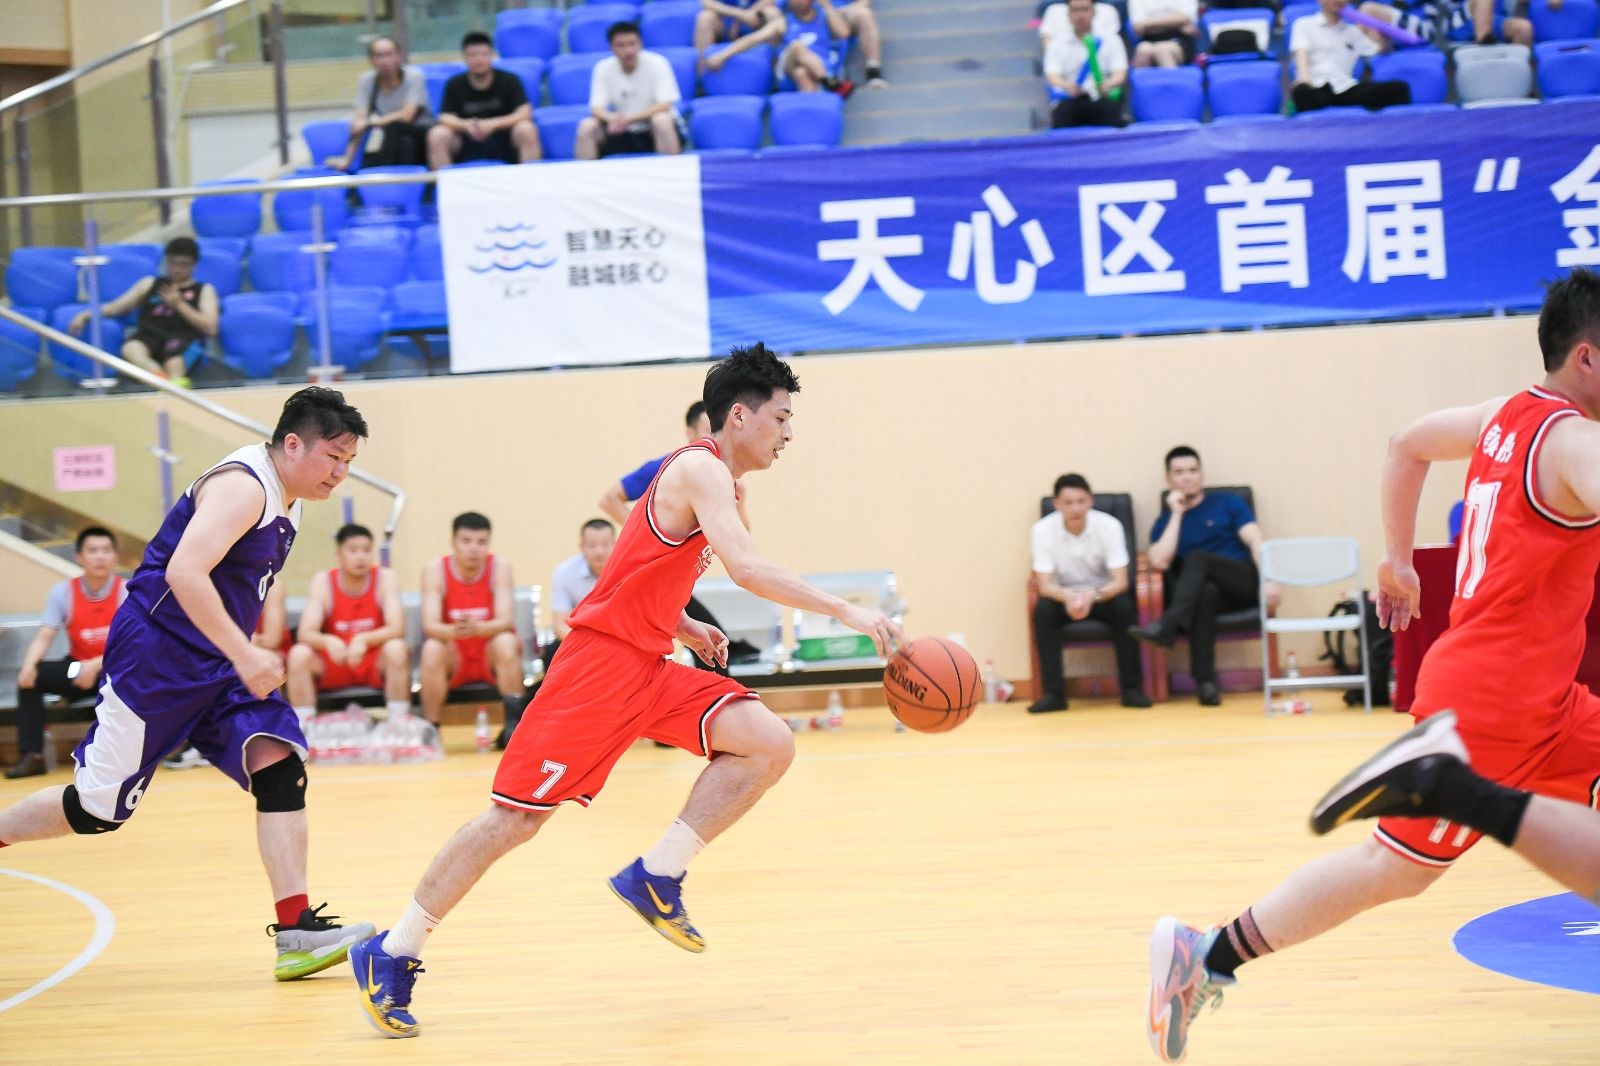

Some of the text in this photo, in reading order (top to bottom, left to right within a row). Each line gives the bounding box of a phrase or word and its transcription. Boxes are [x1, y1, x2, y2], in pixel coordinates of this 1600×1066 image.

[565, 226, 667, 252] 智慧天心
[124, 776, 146, 810] 6
[532, 759, 568, 800] 7
